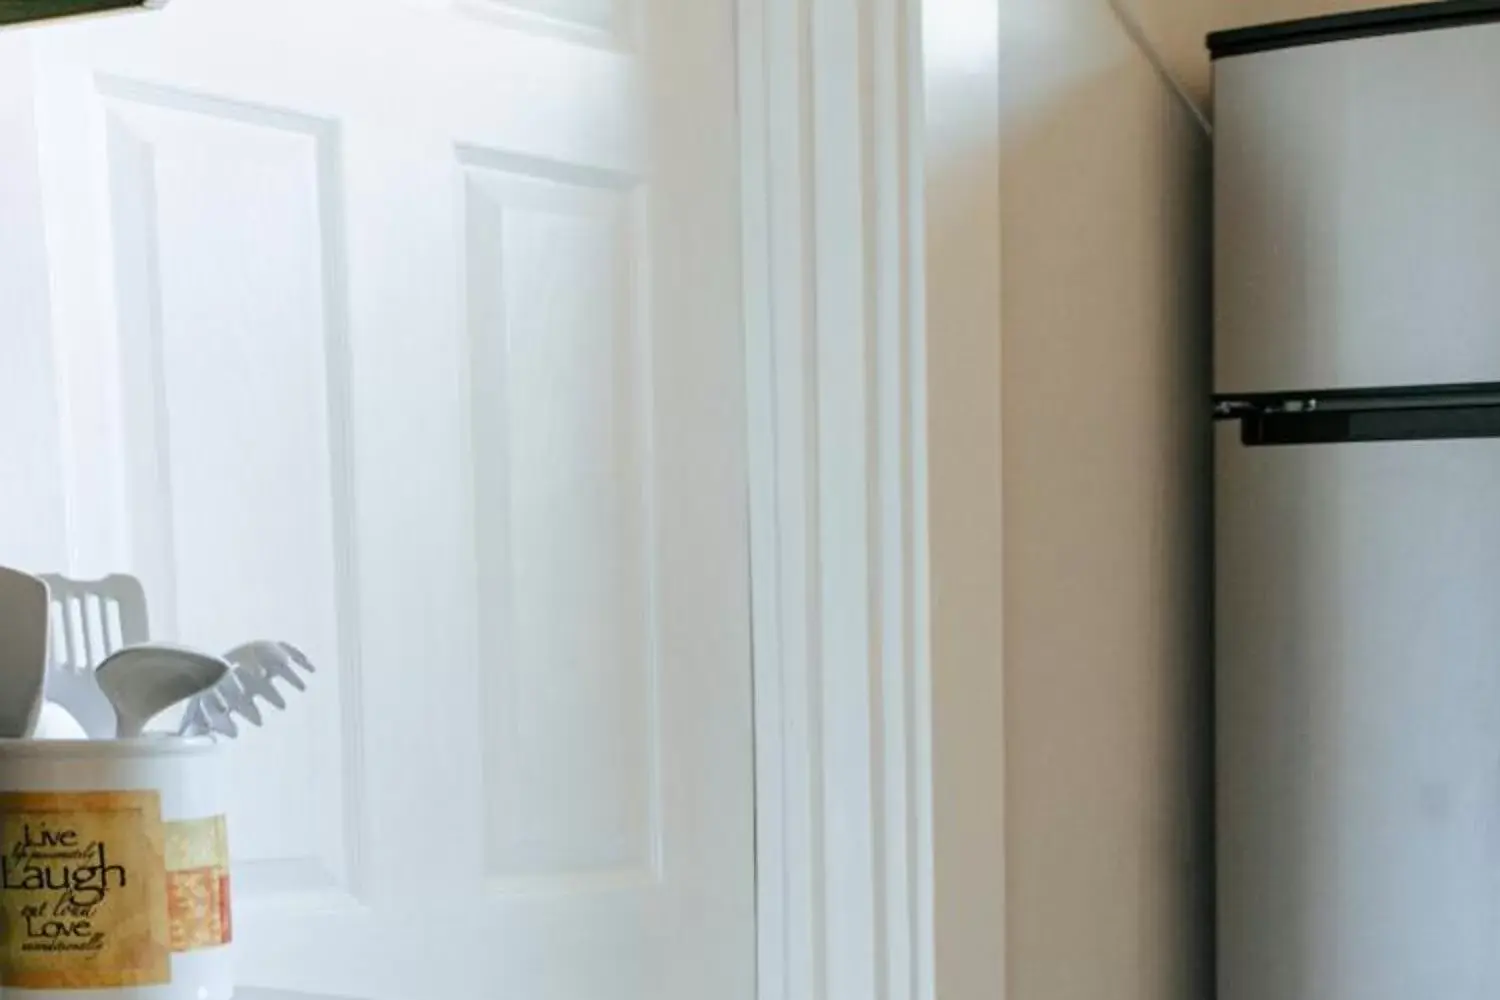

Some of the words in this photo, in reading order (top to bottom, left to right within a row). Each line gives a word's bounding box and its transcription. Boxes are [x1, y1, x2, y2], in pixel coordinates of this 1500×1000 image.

[24, 823, 79, 847] Live
[2, 841, 125, 906] Laugh
[26, 916, 92, 937] Love
